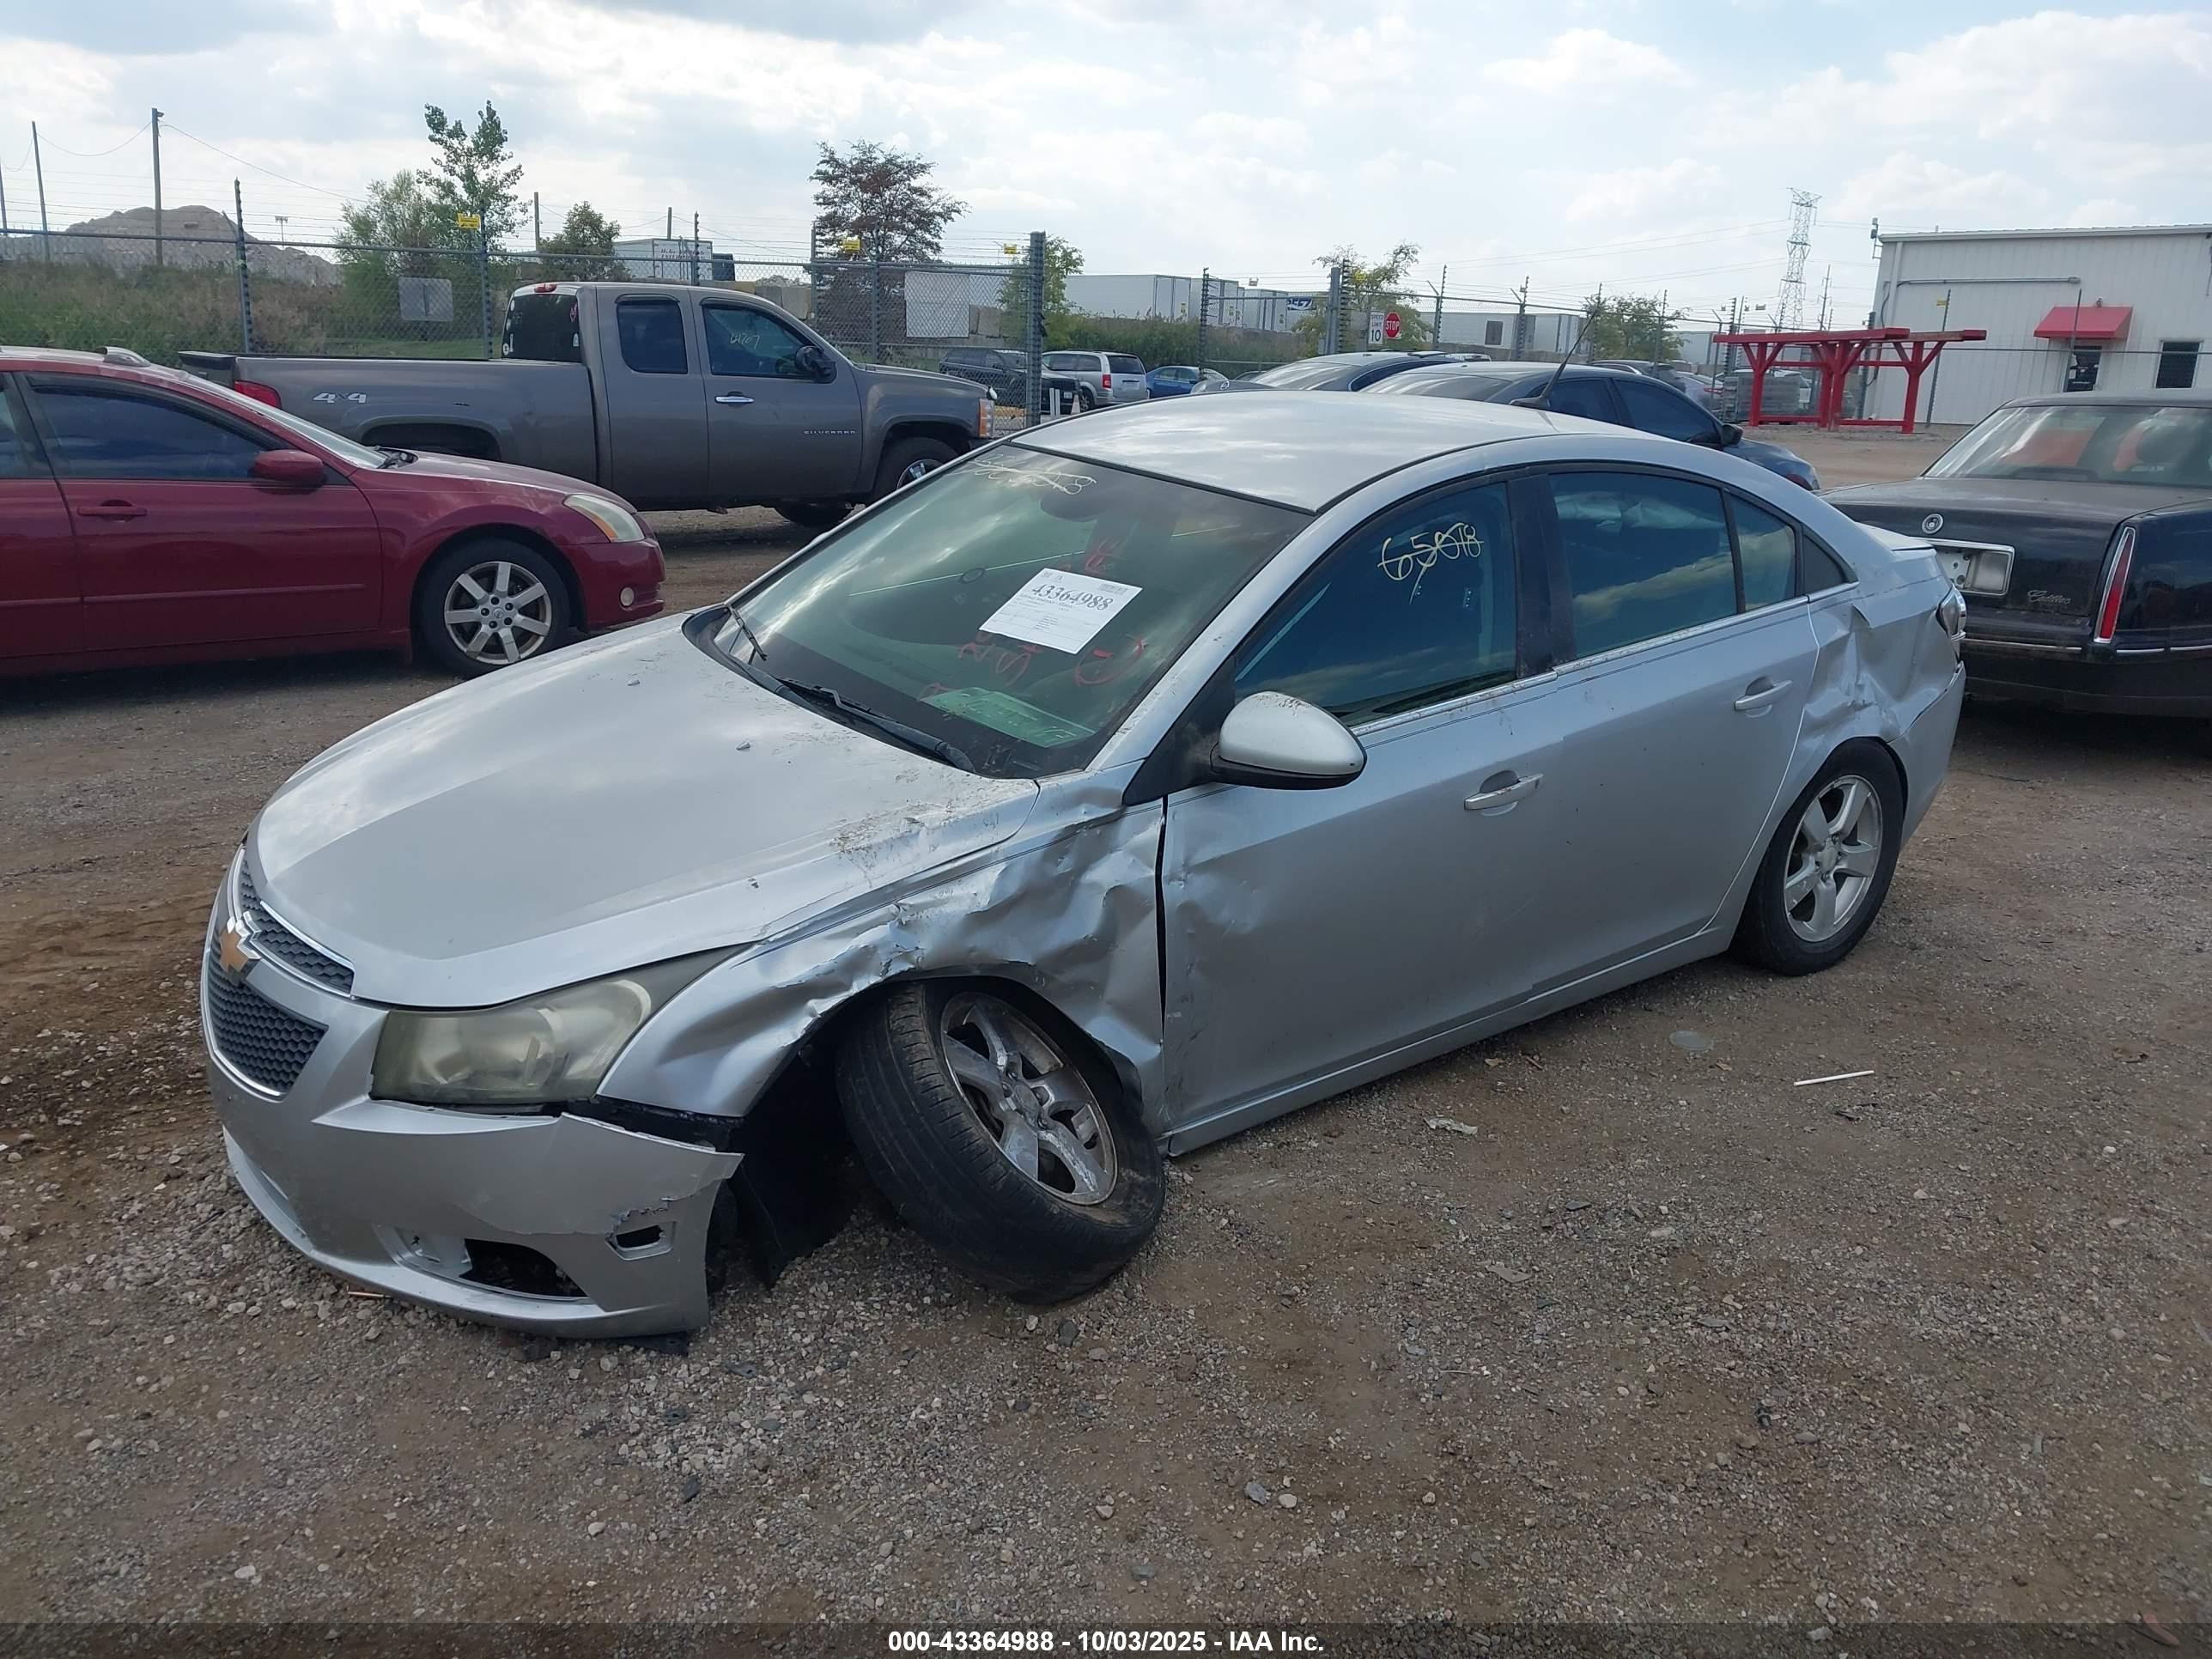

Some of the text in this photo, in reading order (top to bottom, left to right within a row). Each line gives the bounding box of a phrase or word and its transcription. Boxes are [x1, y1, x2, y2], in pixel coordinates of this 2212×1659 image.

[1385, 321, 1400, 331] STOP
[1371, 329, 1382, 342] 10
[1032, 583, 1114, 611] 43364988
